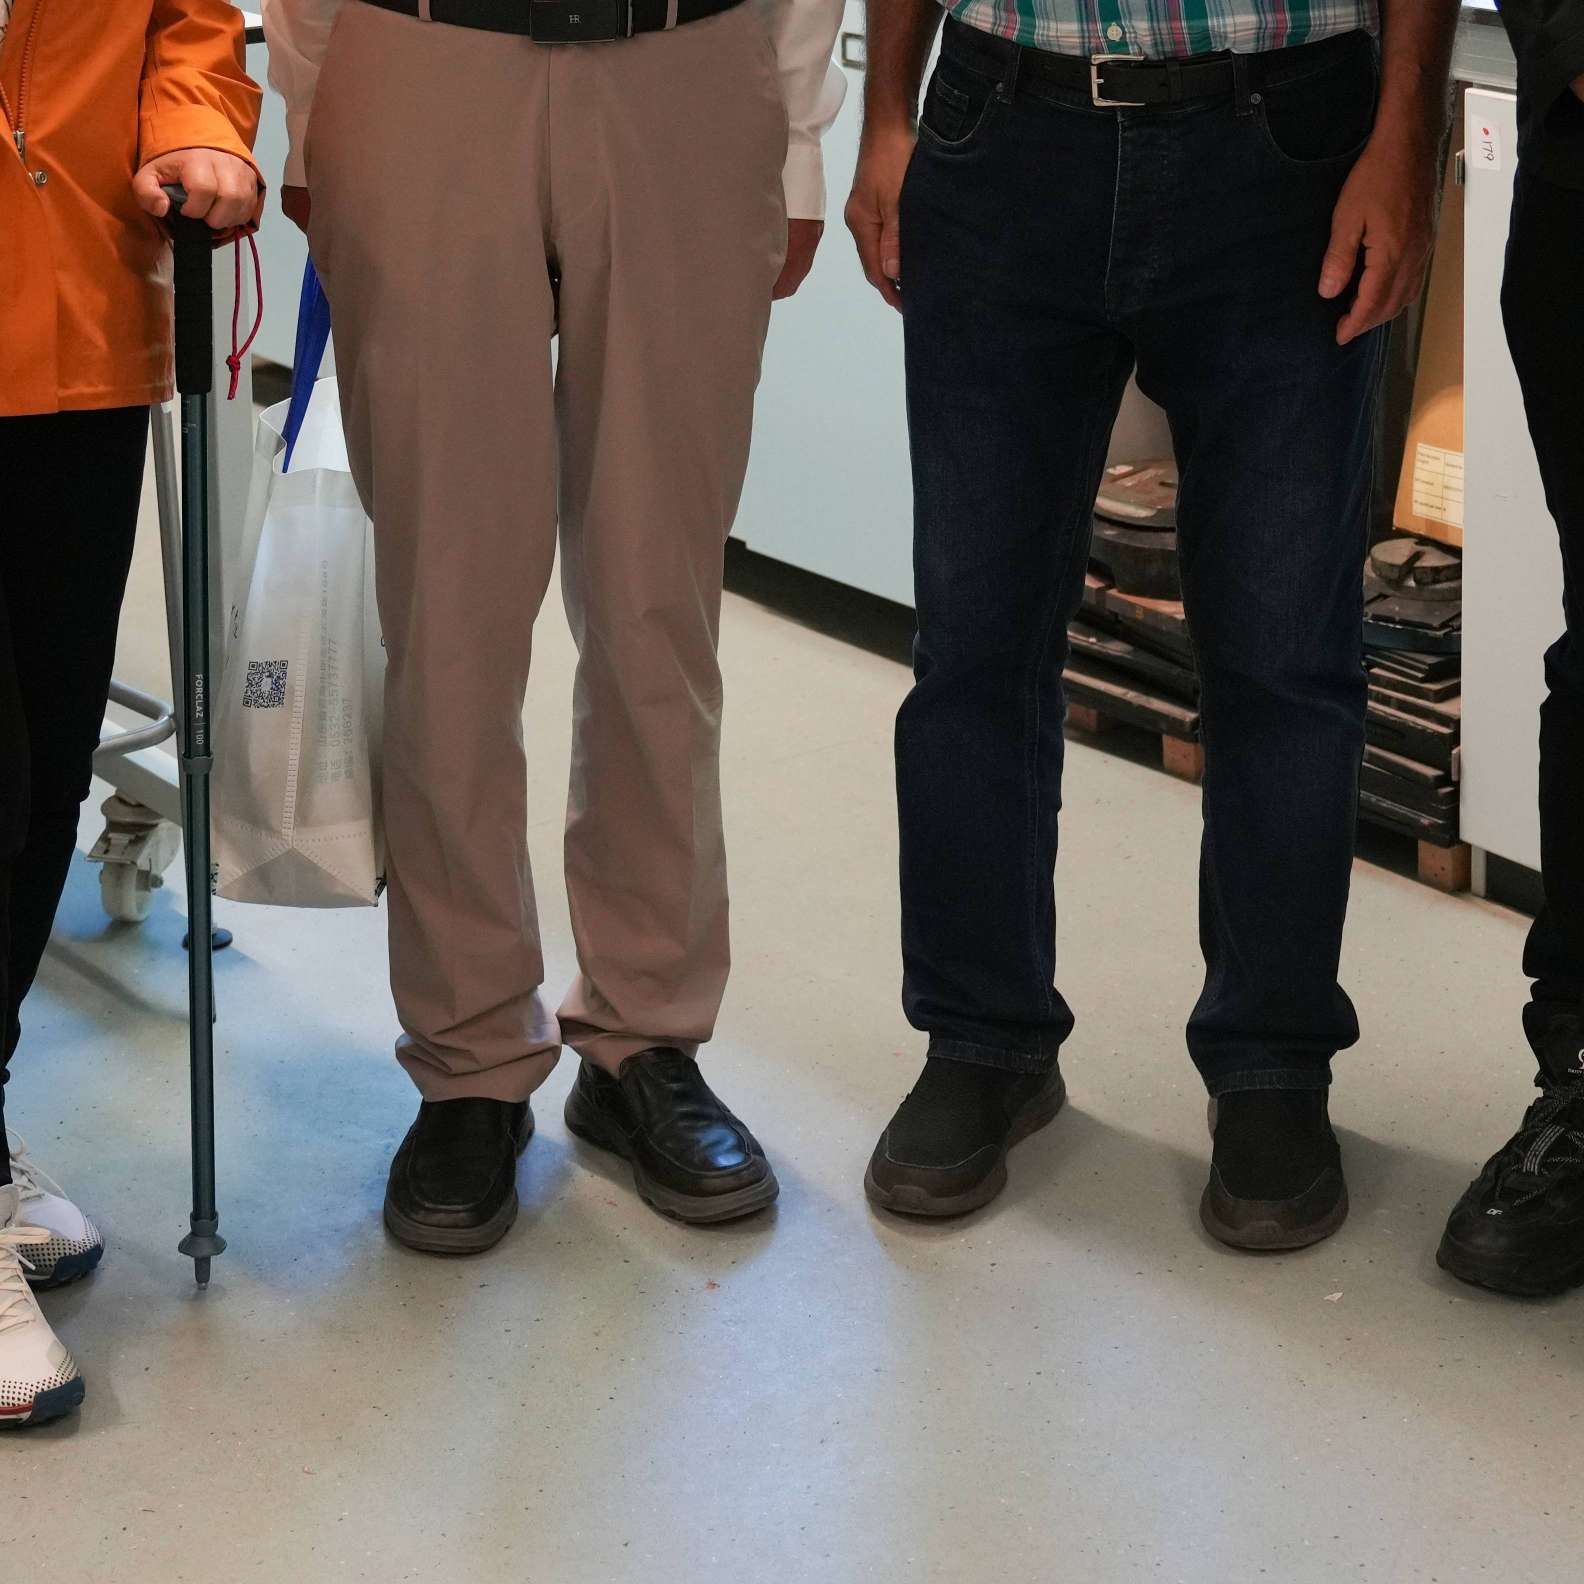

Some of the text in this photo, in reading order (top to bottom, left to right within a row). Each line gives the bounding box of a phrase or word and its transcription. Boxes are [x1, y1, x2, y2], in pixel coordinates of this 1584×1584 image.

[1481, 141, 1495, 161] 179
[196, 673, 204, 745] FORCLAZ 100
